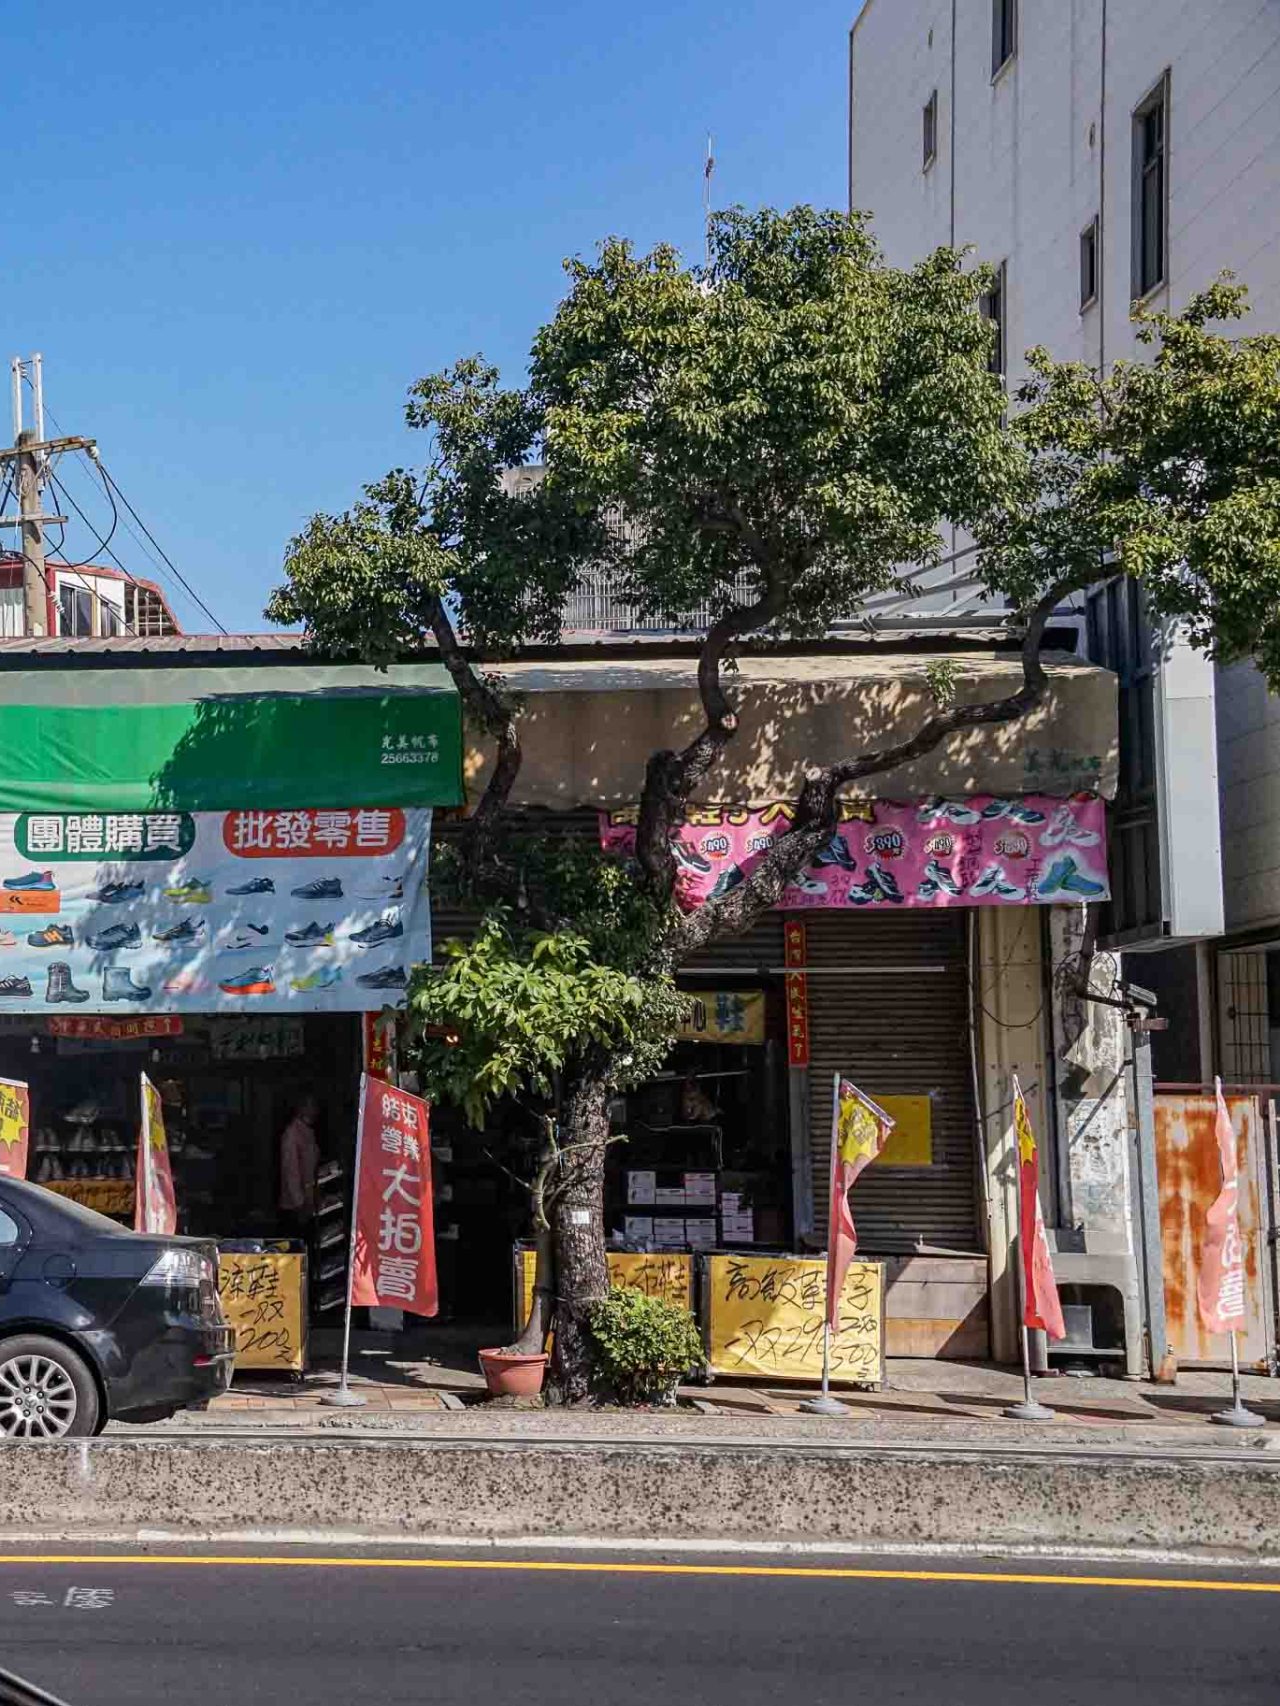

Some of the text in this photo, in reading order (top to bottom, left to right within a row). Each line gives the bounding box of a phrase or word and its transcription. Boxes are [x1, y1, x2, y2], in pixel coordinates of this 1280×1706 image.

[381, 751, 439, 764] 25663378
[27, 815, 183, 853] 團體購買
[233, 809, 391, 850] 批發零售
[381, 1094, 418, 1130] 結束
[381, 1125, 420, 1160] 營業
[376, 1163, 421, 1302] 大拍賣
